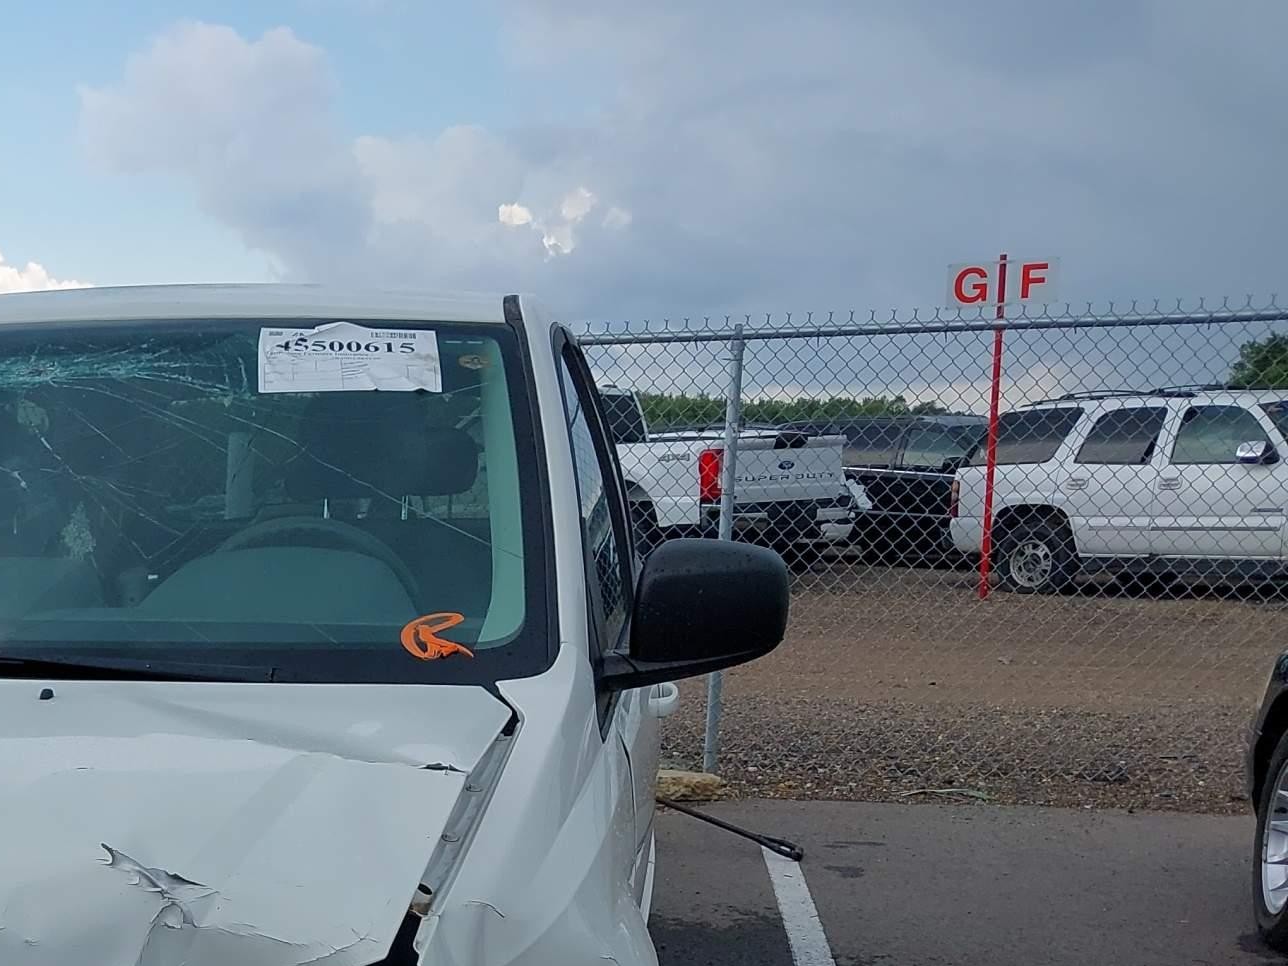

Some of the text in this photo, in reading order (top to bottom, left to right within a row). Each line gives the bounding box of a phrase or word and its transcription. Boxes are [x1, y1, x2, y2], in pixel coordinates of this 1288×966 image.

[954, 262, 1049, 304] G F
[275, 337, 416, 354] 45500615
[735, 471, 834, 483] SUPER DUTY
